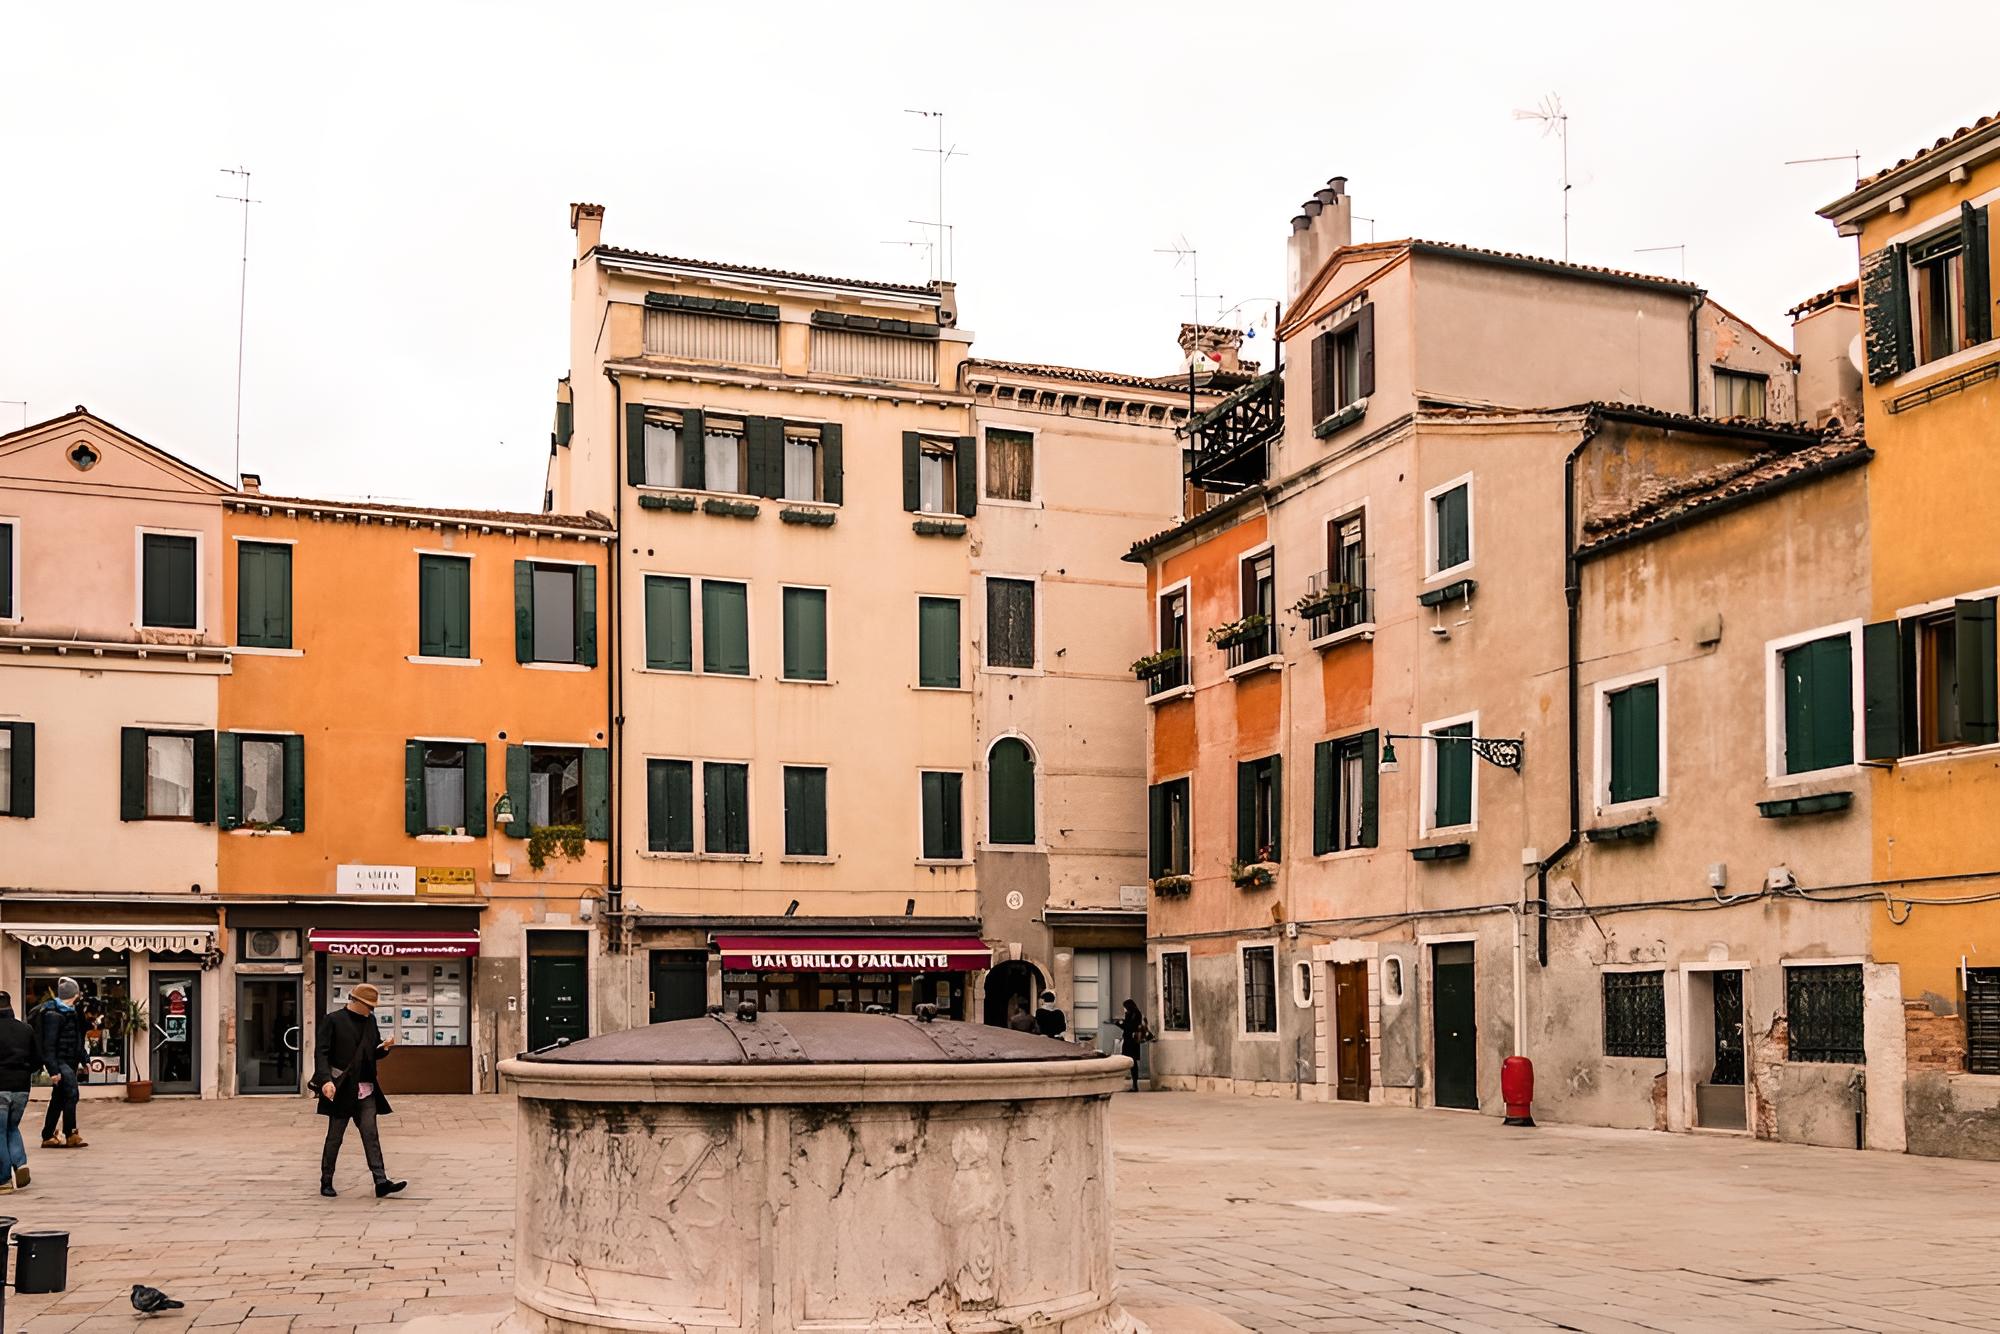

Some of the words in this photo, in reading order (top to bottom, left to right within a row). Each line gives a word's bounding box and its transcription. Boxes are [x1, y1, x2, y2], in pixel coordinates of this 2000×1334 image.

[328, 943, 379, 956] CIVICO
[751, 954, 788, 968] BAR
[857, 954, 948, 968] PARLANTE
